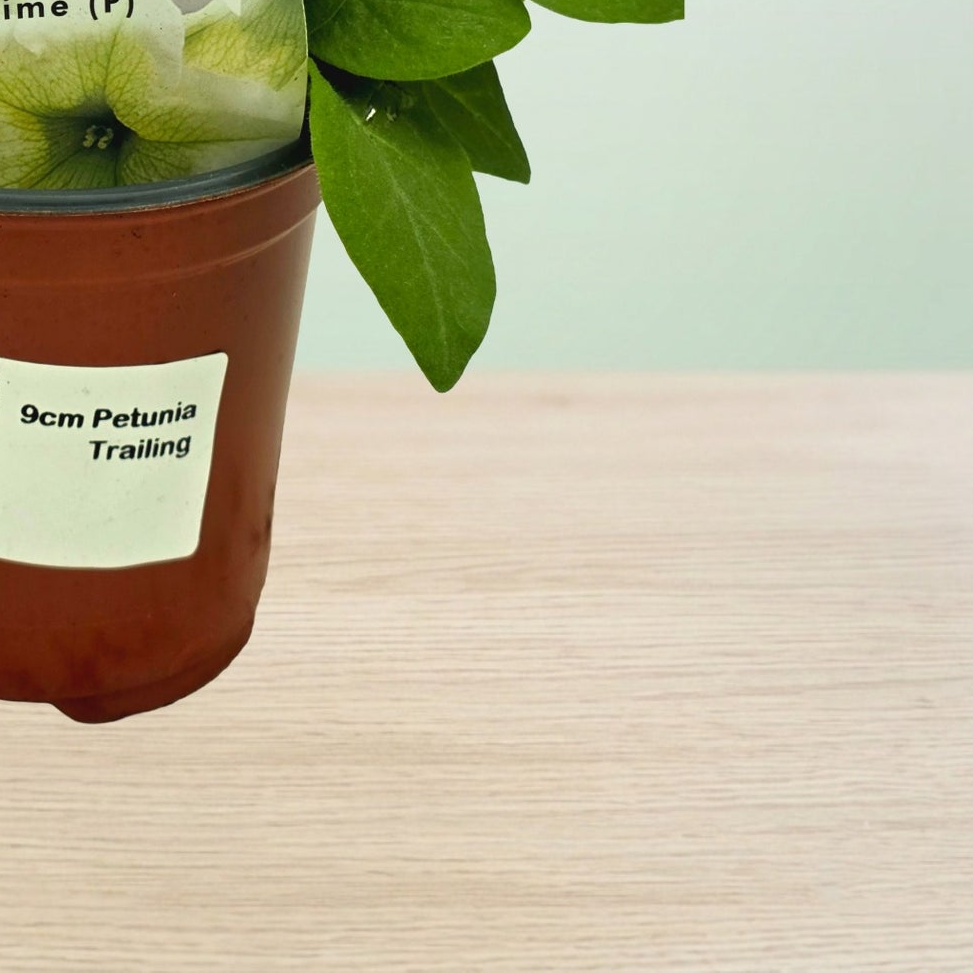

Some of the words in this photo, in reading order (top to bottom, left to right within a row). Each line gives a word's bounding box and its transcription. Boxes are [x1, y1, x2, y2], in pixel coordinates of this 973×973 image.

[20, 404, 85, 428] 9cm
[92, 401, 197, 428] Petunia
[89, 435, 192, 460] Trailing
